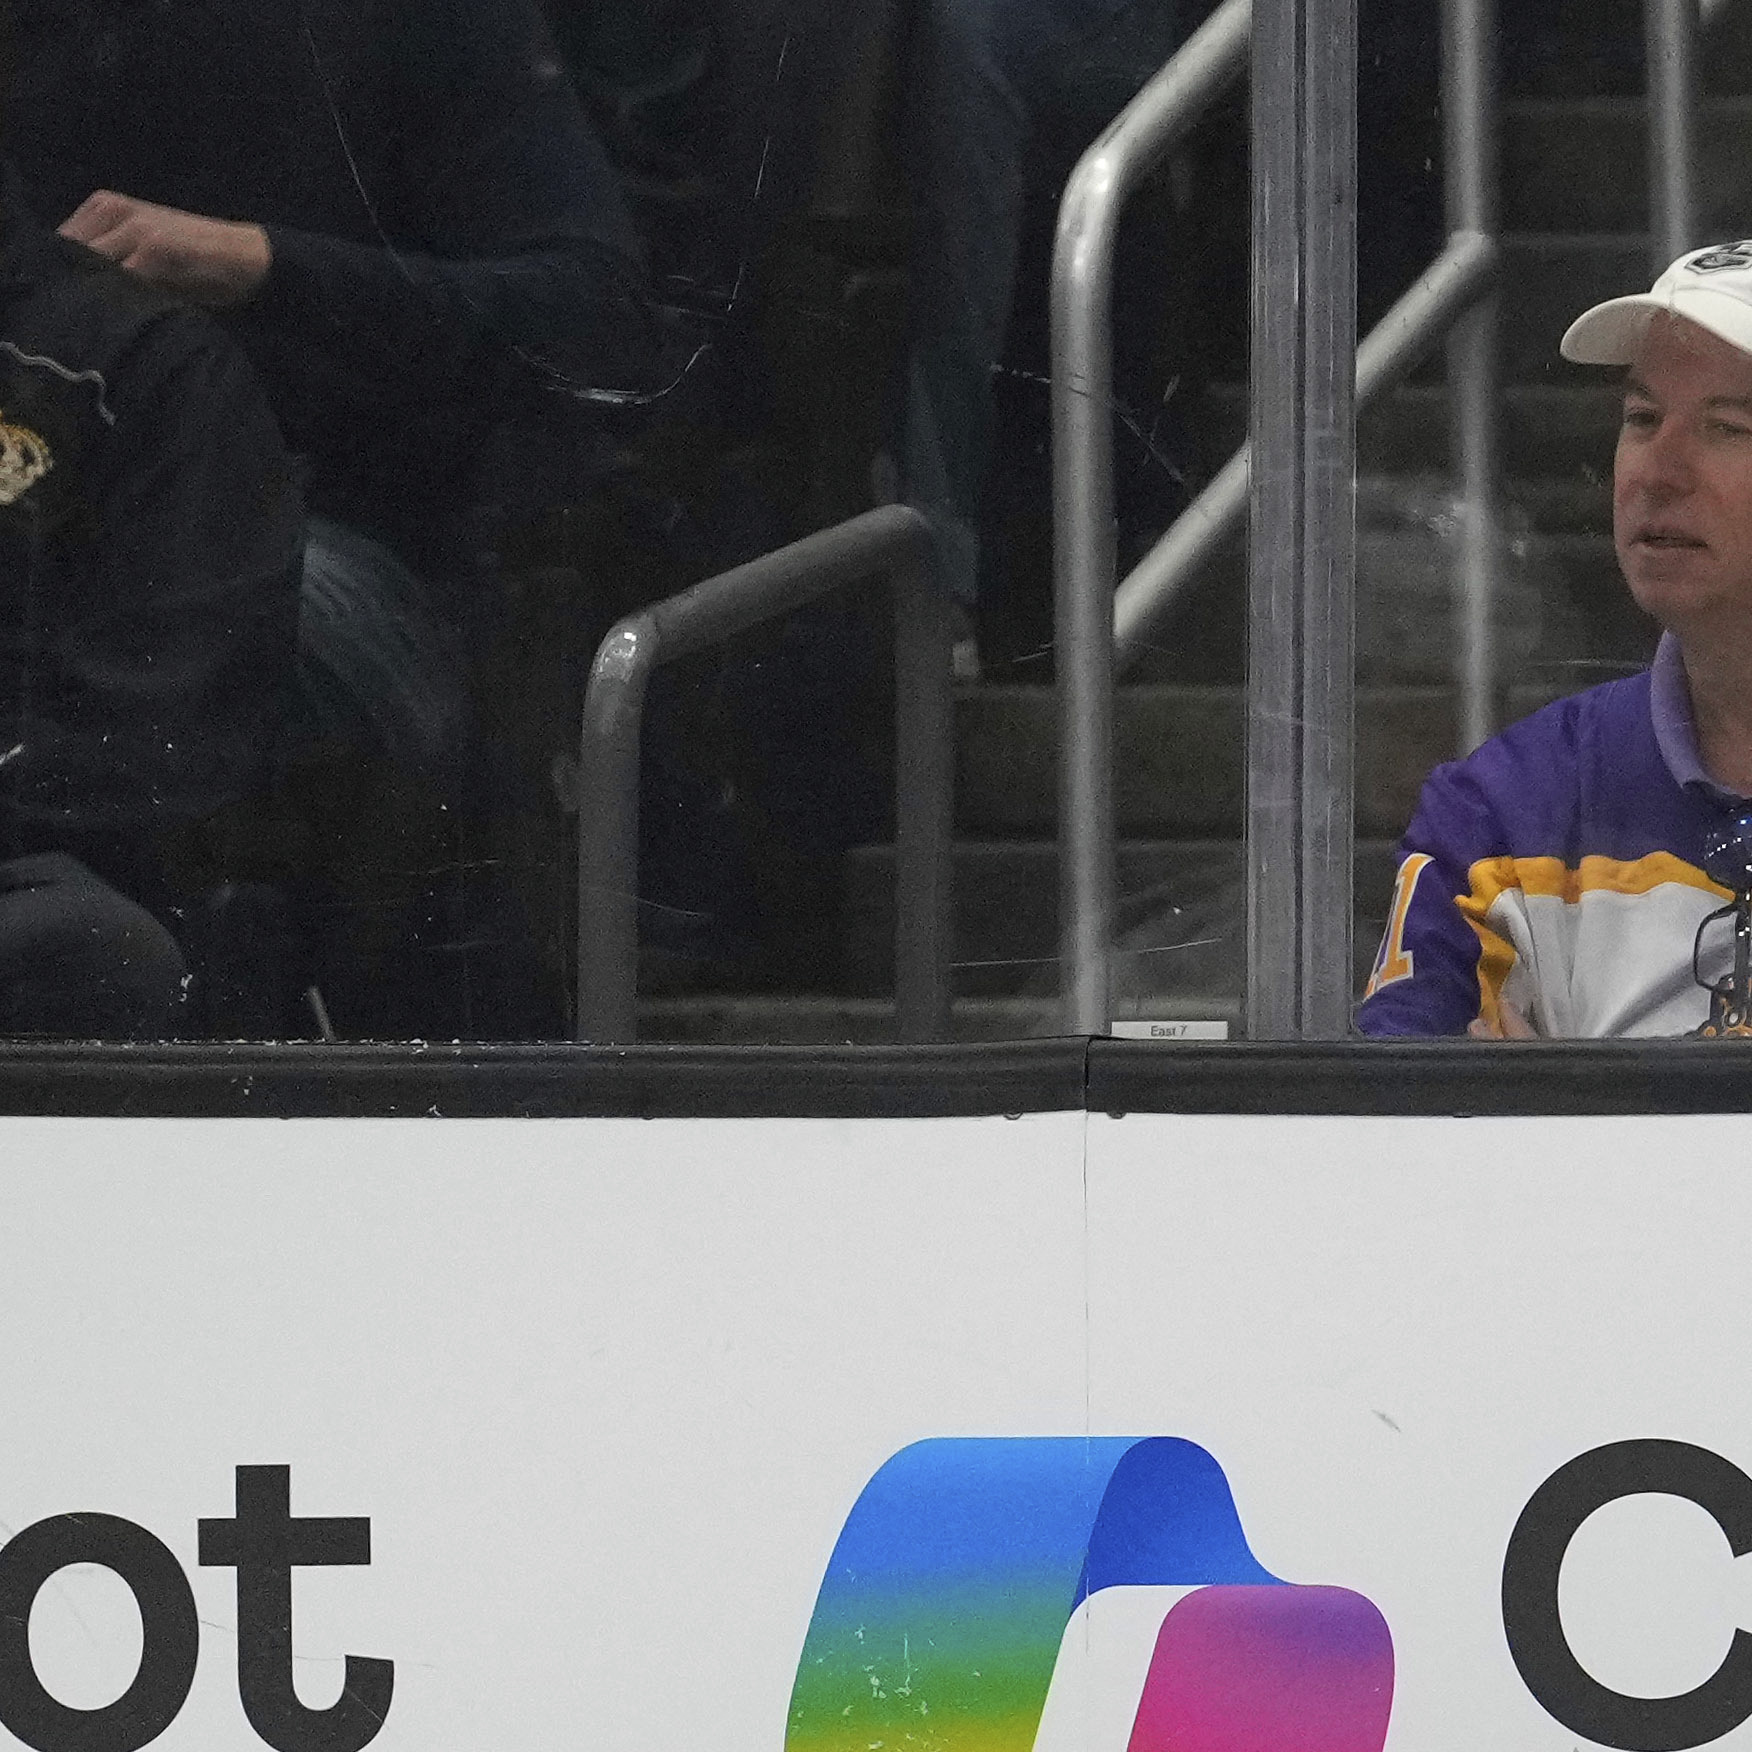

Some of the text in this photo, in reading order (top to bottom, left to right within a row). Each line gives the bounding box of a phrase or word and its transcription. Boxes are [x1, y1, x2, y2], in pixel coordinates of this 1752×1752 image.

[1363, 853, 1436, 1003] 1
[1150, 1025, 1187, 1037] East 7
